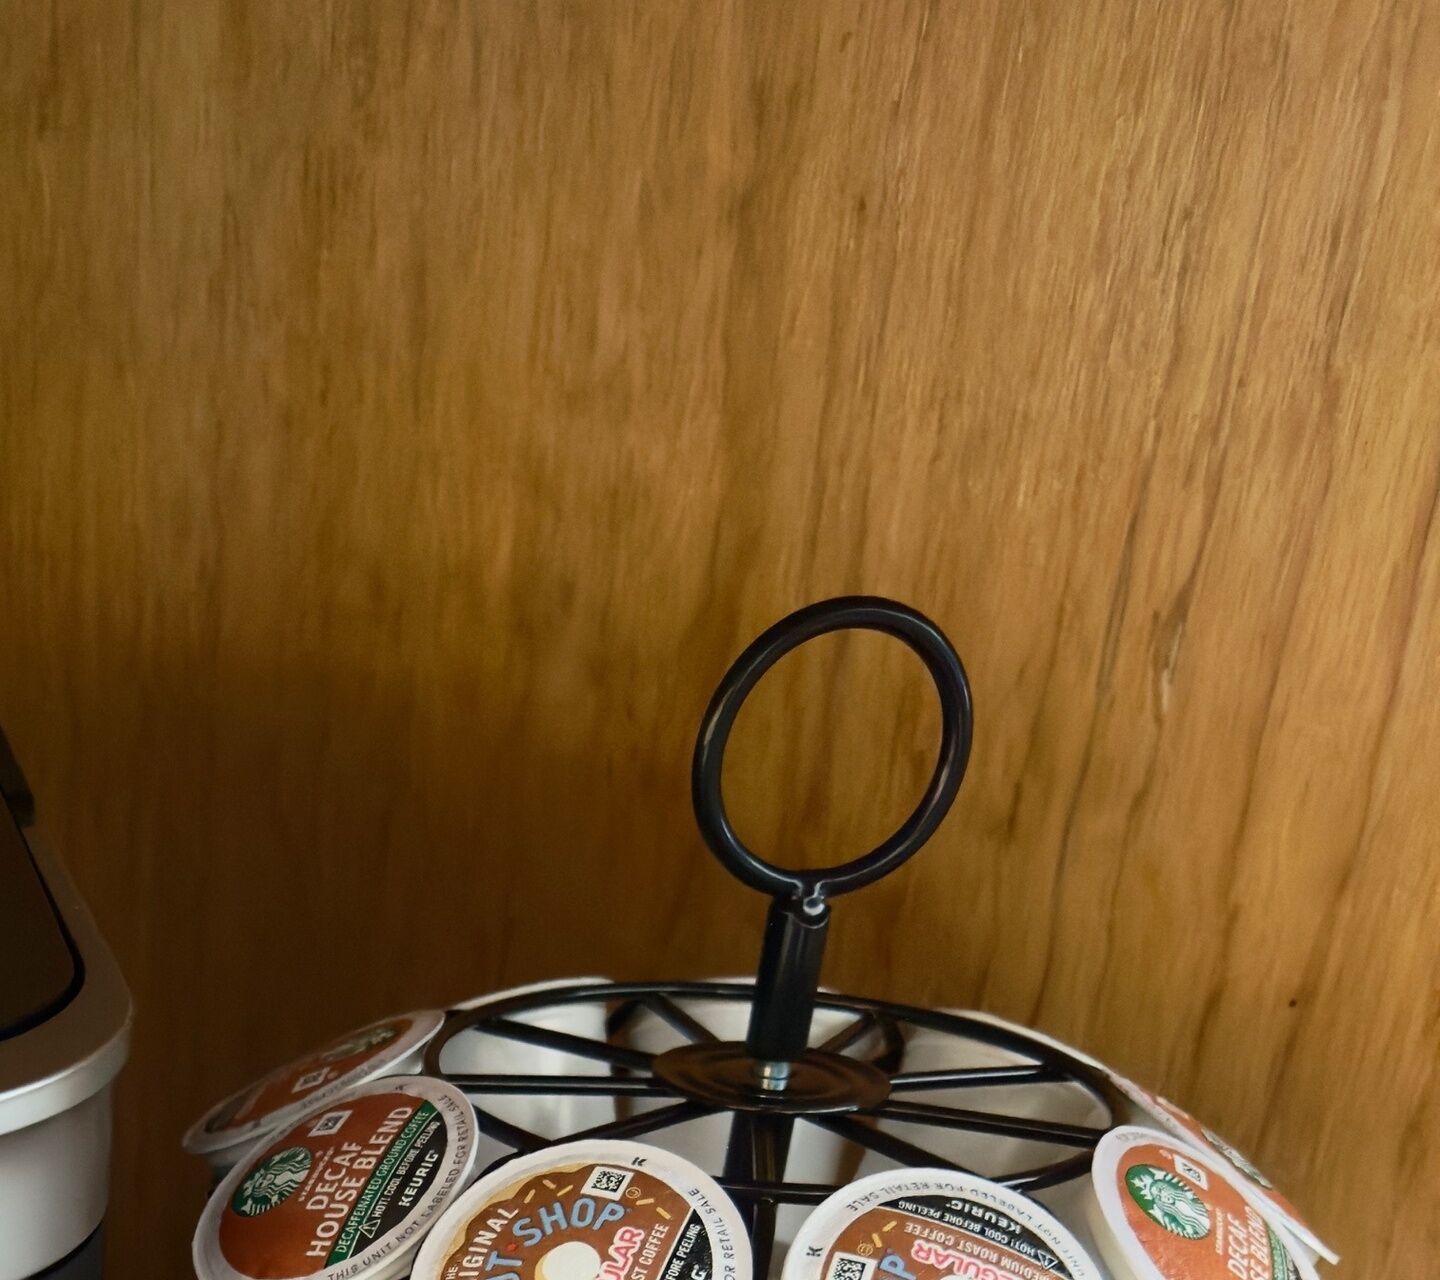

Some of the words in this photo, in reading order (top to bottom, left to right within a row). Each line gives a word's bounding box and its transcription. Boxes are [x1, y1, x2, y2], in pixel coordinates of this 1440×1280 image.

[306, 1141, 361, 1210] DECAF
[306, 1176, 366, 1257] HOUSE
[360, 1107, 413, 1169] BLEND
[336, 1175, 383, 1253] DECAFFEINATED
[376, 1138, 404, 1179] GROUND
[400, 1110, 430, 1141] COFFEE
[399, 1150, 439, 1207] KEURIG
[687, 1186, 717, 1214] SALE
[897, 1199, 942, 1220] PEELING
[946, 1200, 1022, 1235] KEURIG
[512, 1198, 625, 1247] SHOP
[676, 1223, 701, 1260] PEELING
[717, 1216, 736, 1260] RETAIL
[904, 1222, 954, 1246] COFFEE
[942, 1211, 977, 1234] BEFORE
[980, 1225, 1010, 1244] COOL
[641, 1224, 669, 1268] COFFEE
[956, 1239, 996, 1261] ROAST
[1227, 1212, 1249, 1280] DECAF
